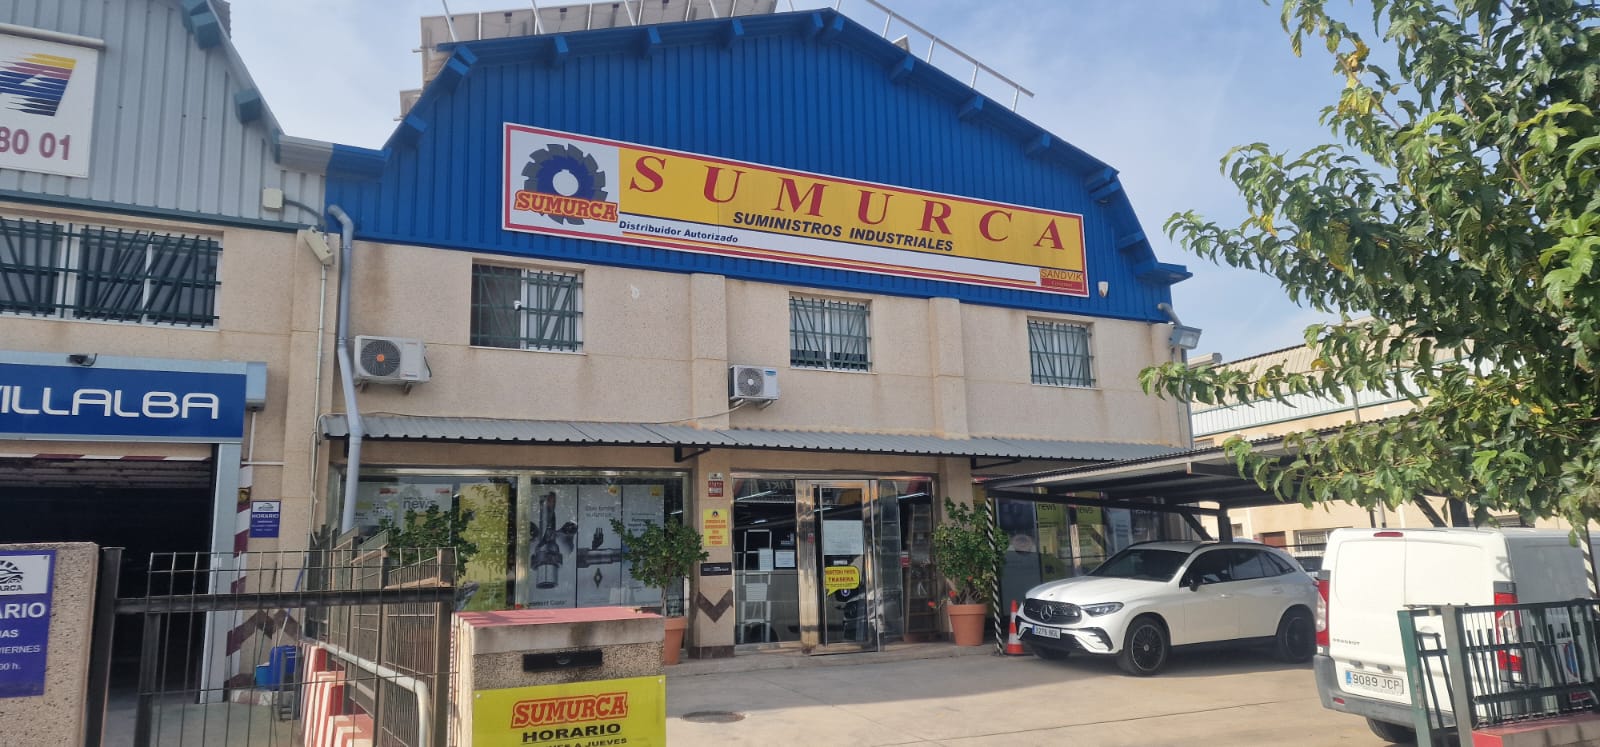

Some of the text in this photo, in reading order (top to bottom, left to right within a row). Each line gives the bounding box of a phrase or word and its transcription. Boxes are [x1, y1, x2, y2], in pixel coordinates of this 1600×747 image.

[39, 132, 71, 160] 01
[514, 190, 618, 223] SUMURCA
[629, 155, 1065, 251] SUMURCA
[618, 220, 739, 243] Distribuidor Autorizado
[732, 211, 954, 252] SUMINISTROS INDUSTRIALES
[1040, 269, 1083, 281] SANDVIK
[0, 385, 219, 420] ILLALBA
[0, 602, 46, 619] RIO
[0, 645, 41, 654] IERNES
[1353, 674, 1400, 690] 9089 JCP
[512, 692, 628, 728] SUMURCA
[522, 723, 621, 743] HORARIO
[586, 738, 627, 747] JUEVES
